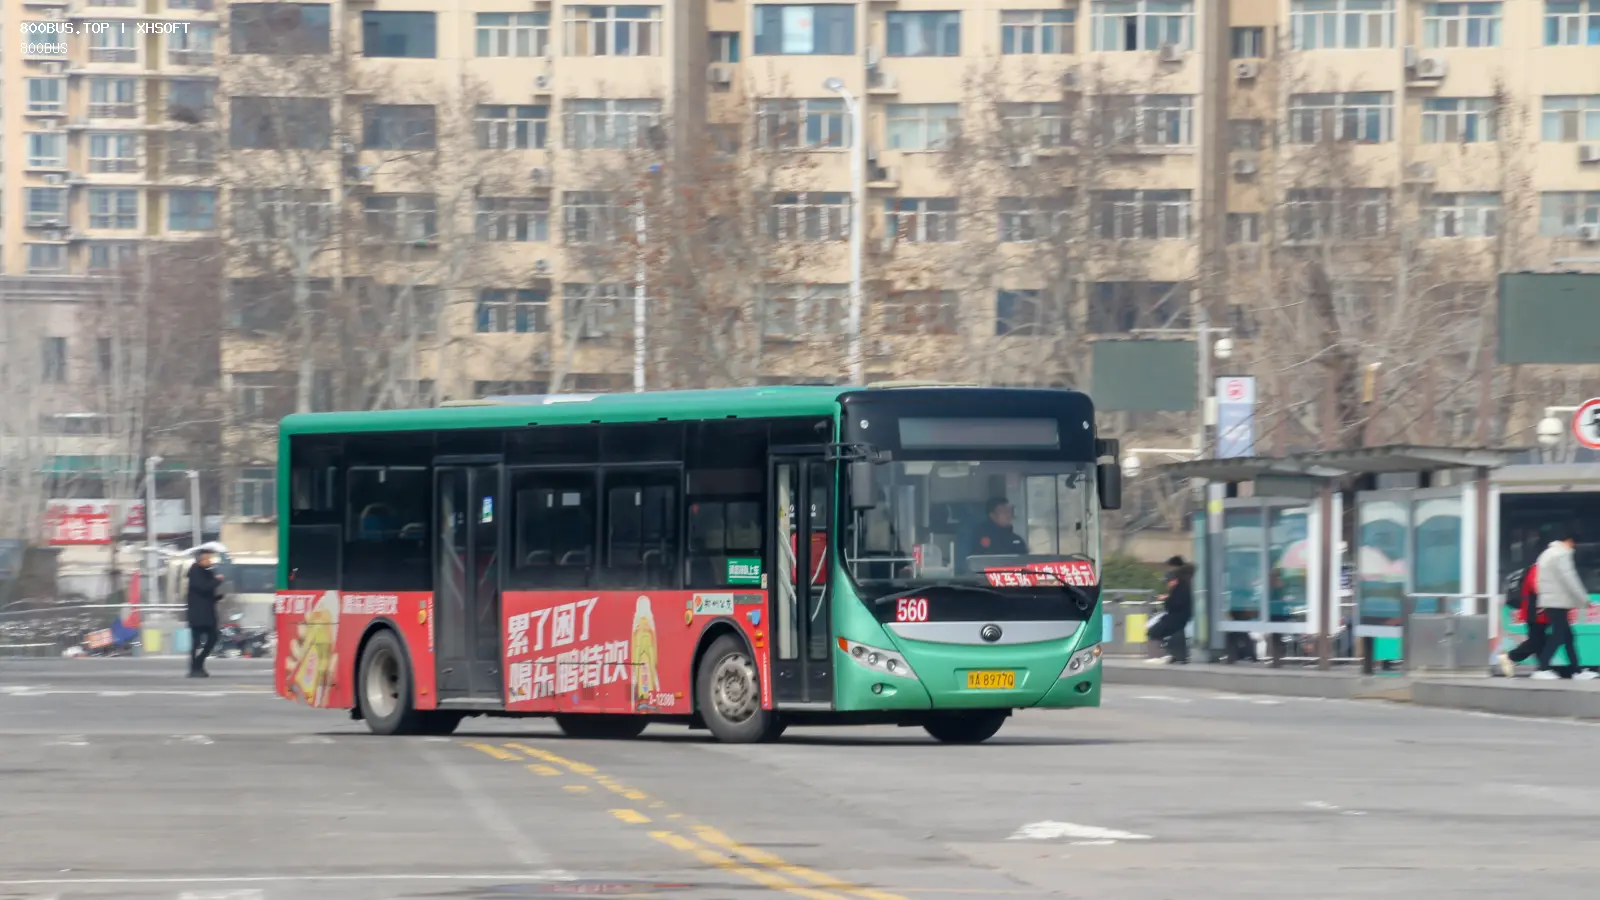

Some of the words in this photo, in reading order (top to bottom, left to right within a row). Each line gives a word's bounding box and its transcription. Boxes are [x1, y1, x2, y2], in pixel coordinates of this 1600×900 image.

[507, 597, 598, 657] 累了困了
[897, 599, 928, 621] 560
[508, 640, 628, 703] 喝东鹏特饮
